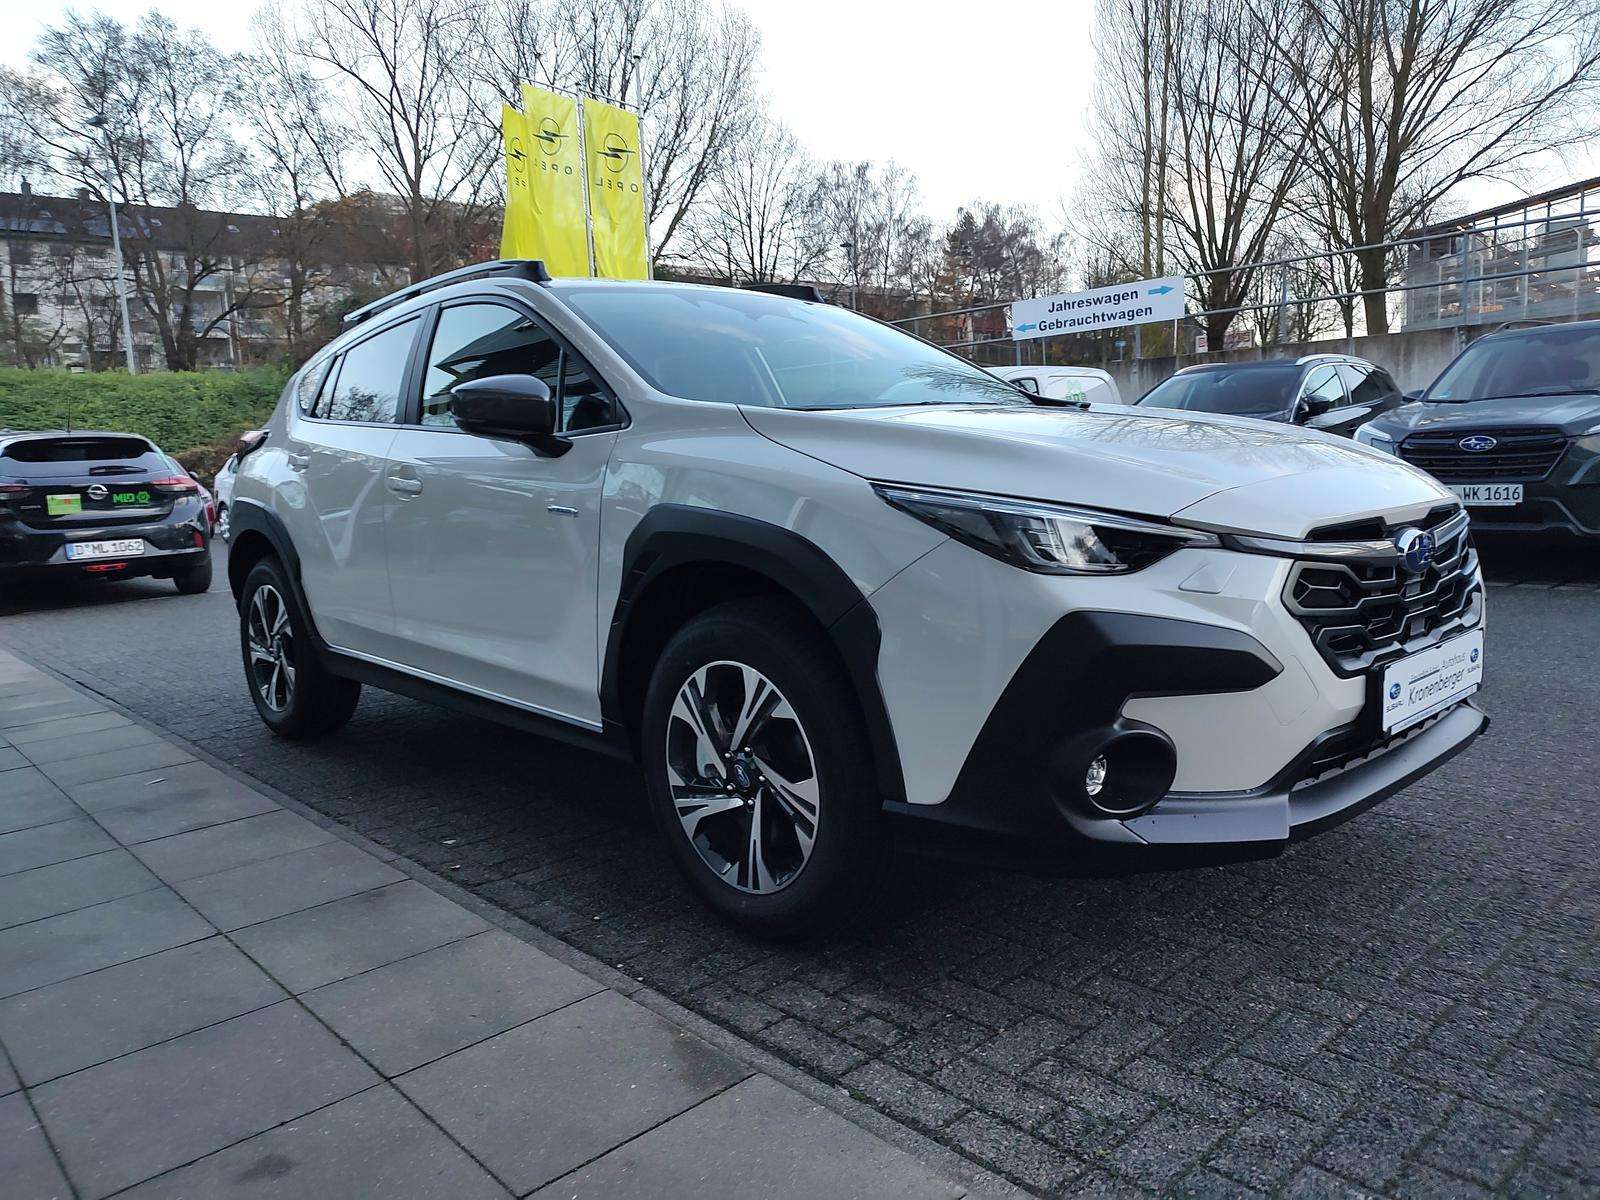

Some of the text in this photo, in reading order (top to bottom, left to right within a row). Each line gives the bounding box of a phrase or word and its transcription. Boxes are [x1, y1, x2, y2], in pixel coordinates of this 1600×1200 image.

[1048, 290, 1139, 313] Jahreswagen
[1038, 306, 1153, 332] Gebrauchtwagen
[1463, 487, 1521, 500] WK 1616
[1408, 668, 1465, 706] Kronenberger
